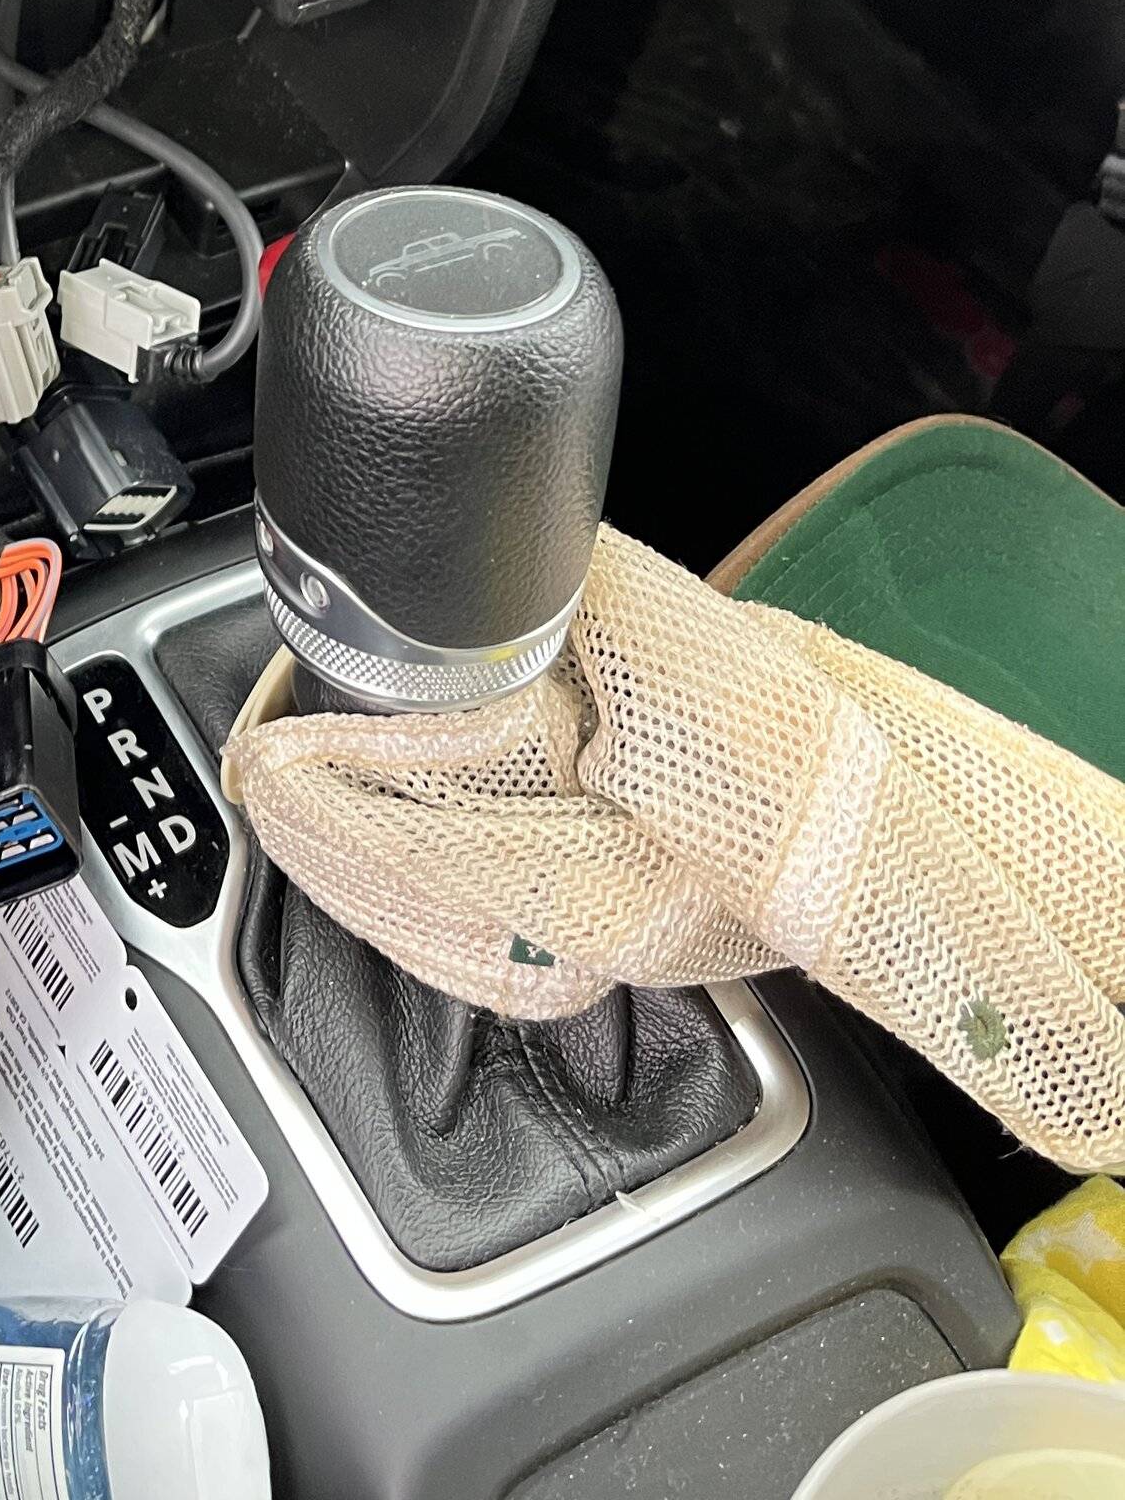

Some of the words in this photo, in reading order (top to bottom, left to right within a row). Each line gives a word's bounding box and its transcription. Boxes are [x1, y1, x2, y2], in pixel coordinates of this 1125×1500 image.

[82, 687, 113, 724] P
[107, 728, 148, 767] R
[131, 766, 175, 810] N
[158, 814, 197, 855] D
[112, 830, 162, 881] M
[24, 1368, 34, 1399] Active
[35, 1370, 49, 1397] Drug
[37, 1399, 48, 1430] Facts
